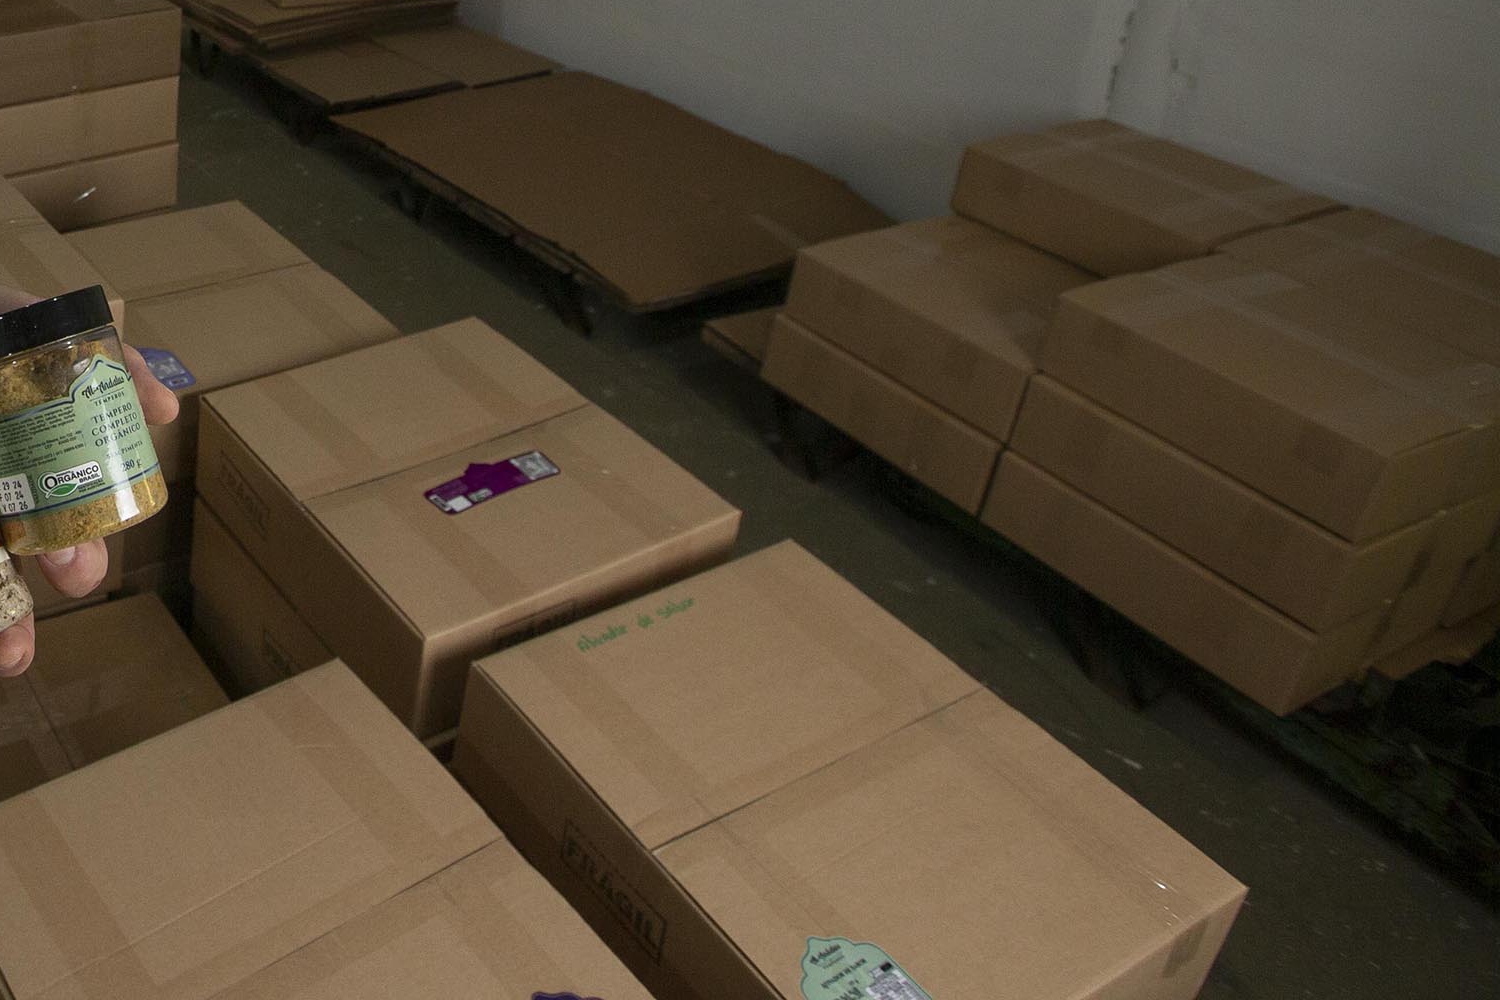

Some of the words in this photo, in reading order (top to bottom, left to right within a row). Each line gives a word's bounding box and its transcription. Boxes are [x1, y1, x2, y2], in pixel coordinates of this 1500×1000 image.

[95, 392, 125, 406] TEMPEROS
[92, 402, 132, 424] TEMPERO
[92, 412, 137, 436] COMPLETO
[95, 423, 140, 447] ORGÂNICO
[44, 465, 99, 490] ORGÂNICO
[79, 473, 100, 484] BRASIL
[20, 501, 28, 510] 26
